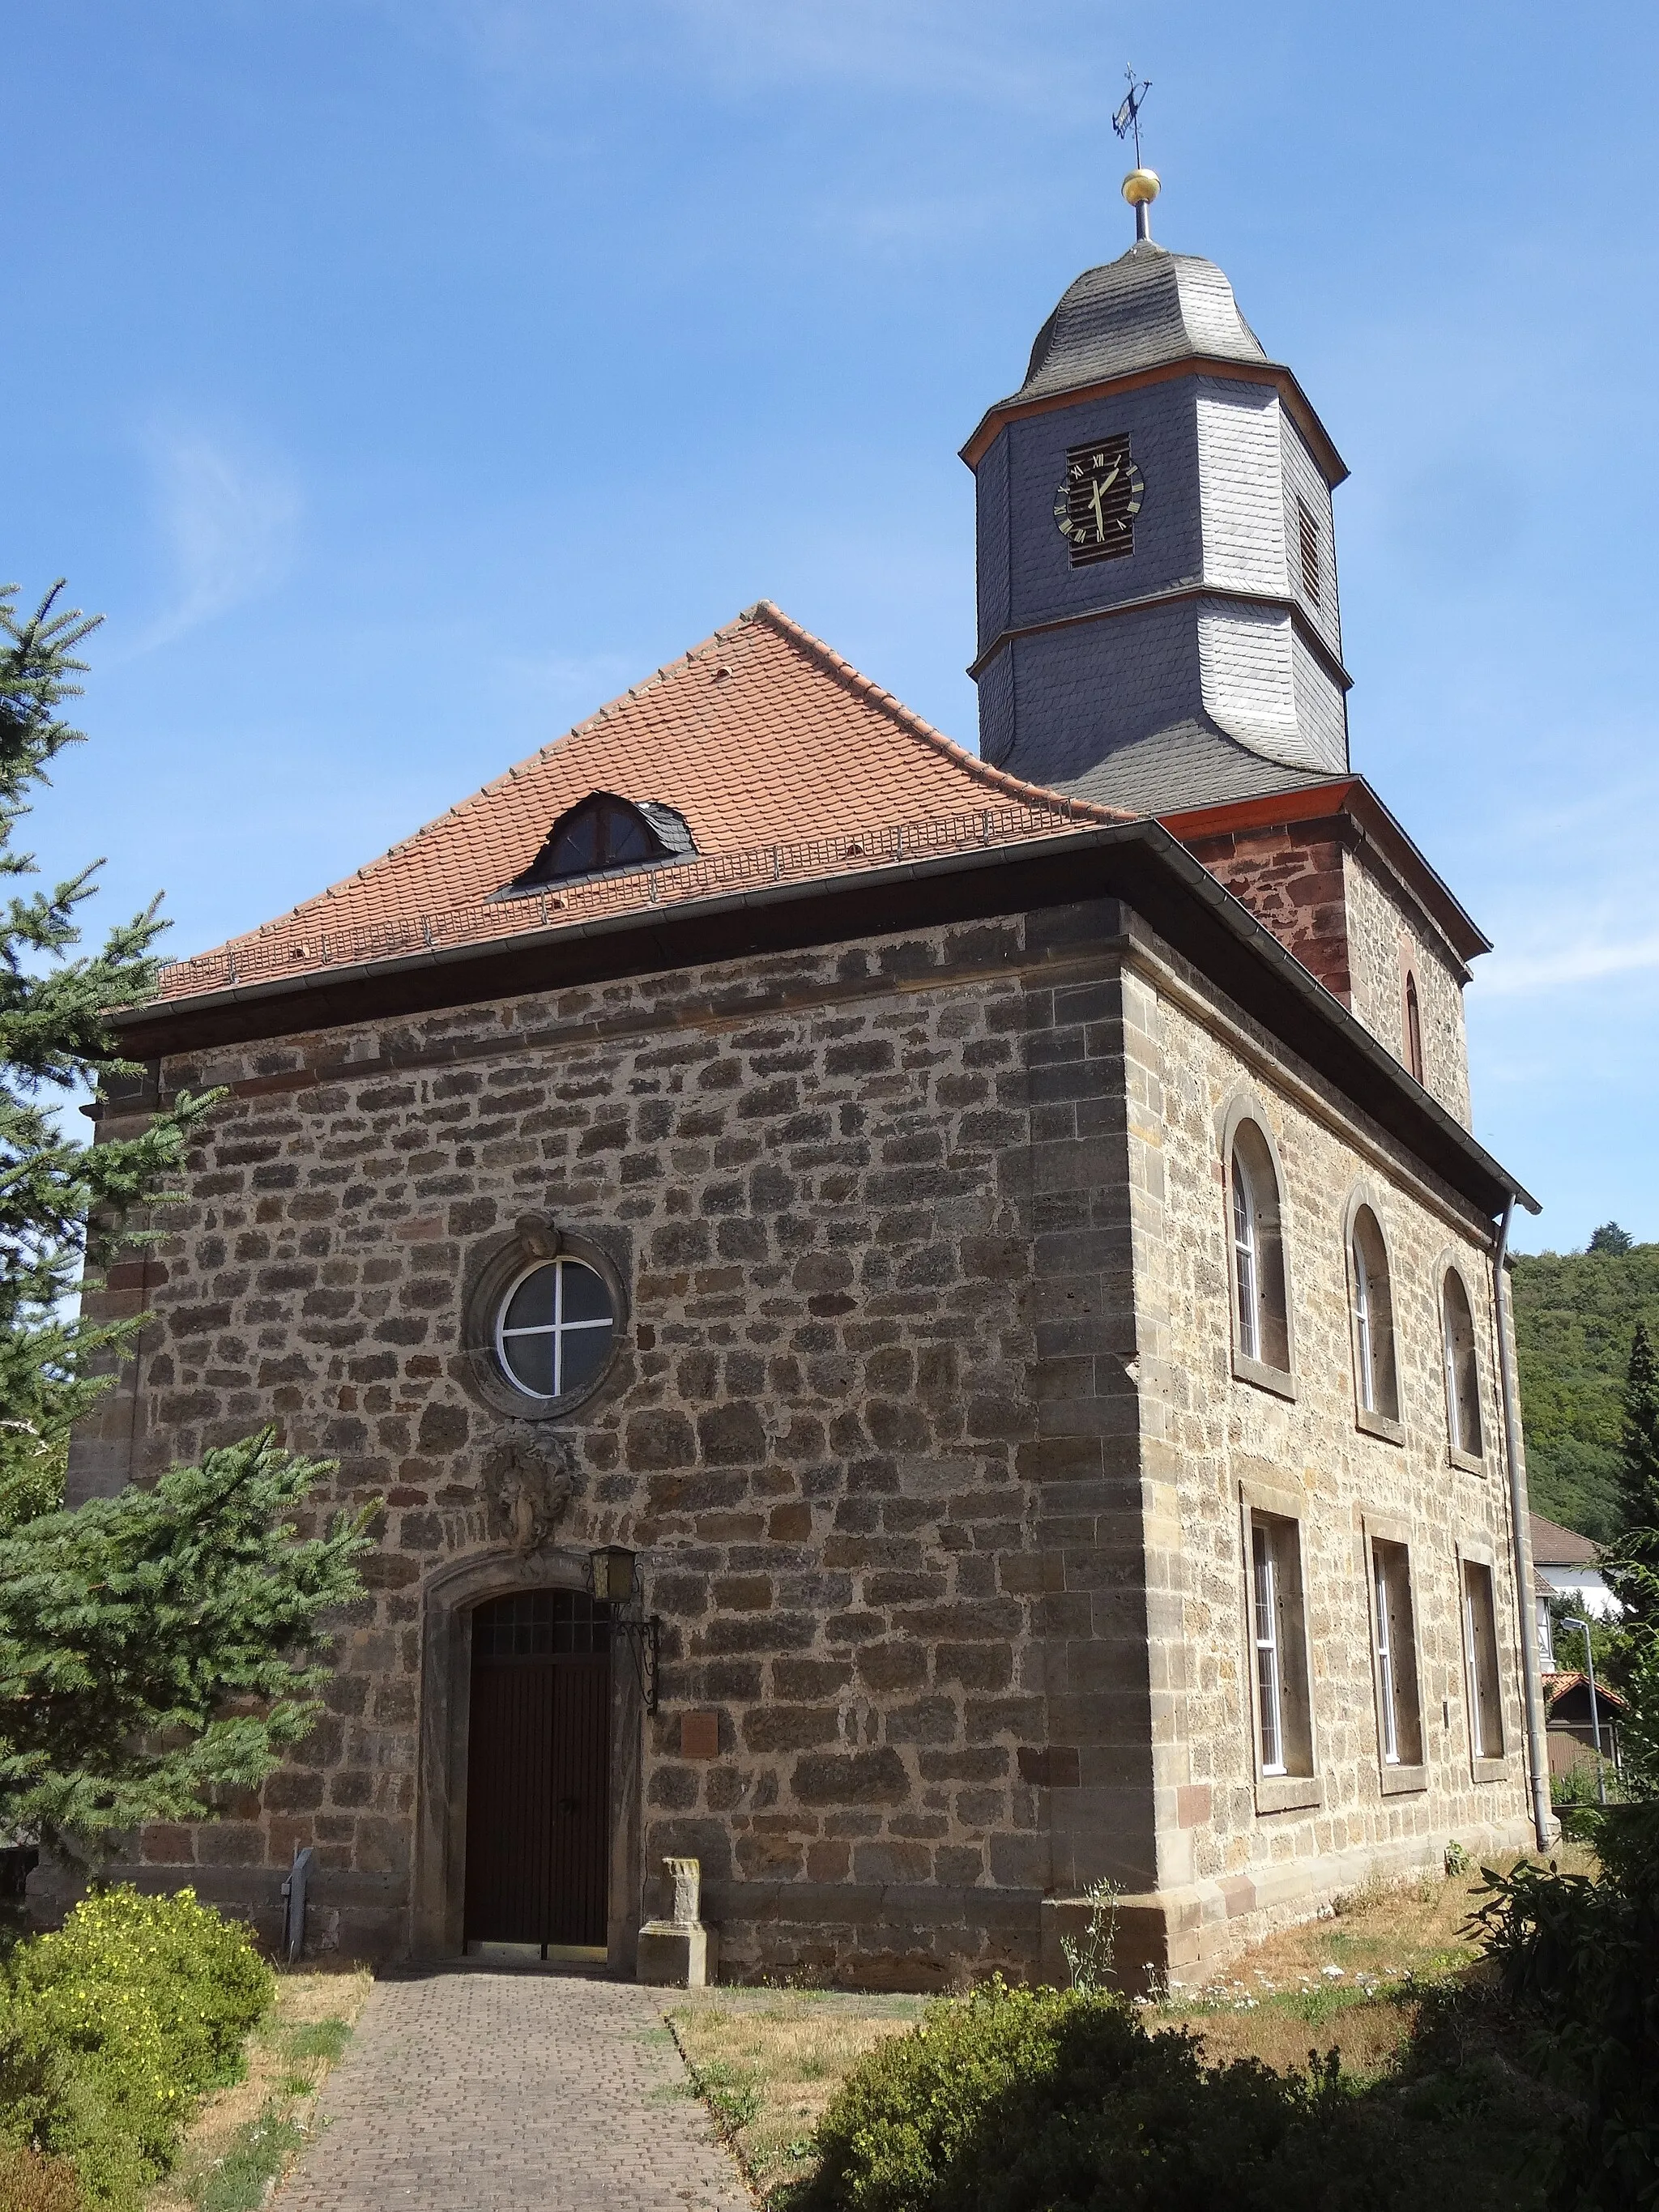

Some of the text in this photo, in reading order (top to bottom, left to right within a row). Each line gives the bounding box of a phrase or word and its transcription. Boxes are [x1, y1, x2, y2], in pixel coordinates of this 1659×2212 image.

[1093, 453, 1104, 468] XII
[1070, 465, 1084, 479] XI
[1058, 485, 1070, 494] X
[1054, 505, 1067, 515] IX
[1116, 519, 1127, 531] V
